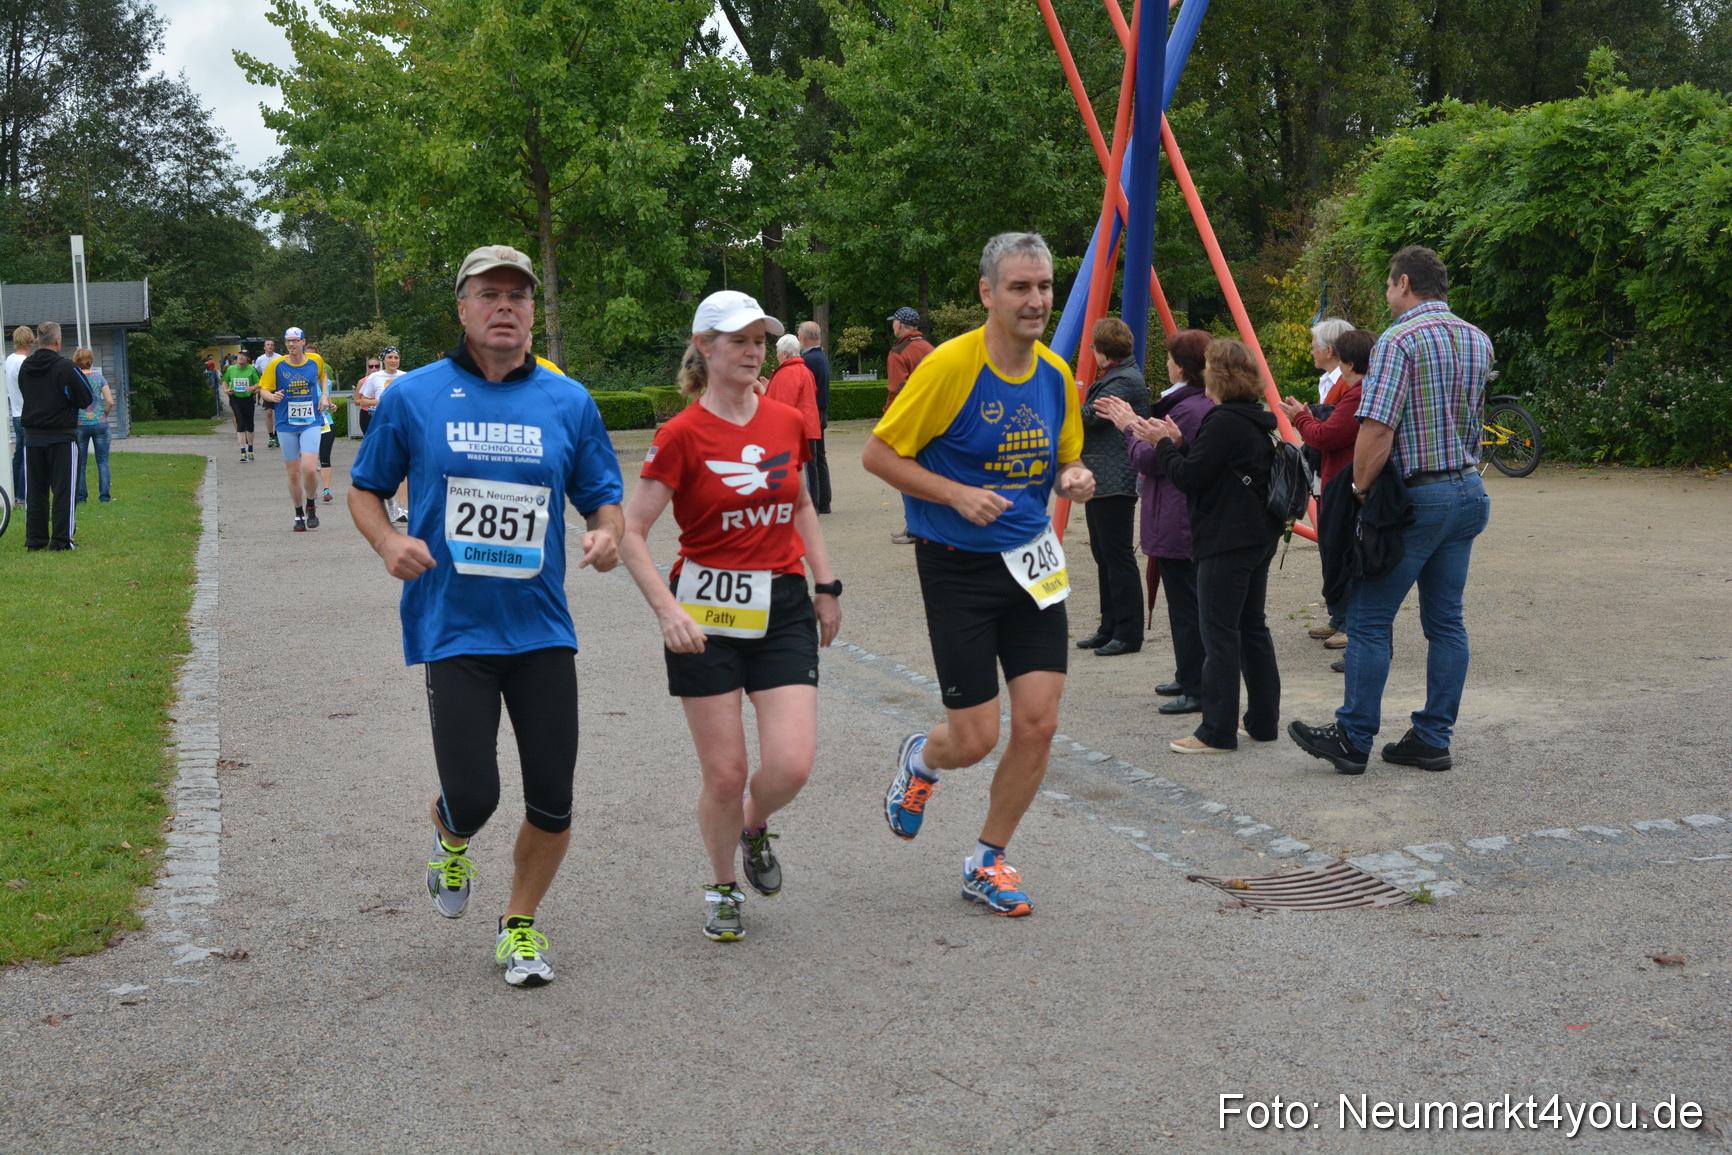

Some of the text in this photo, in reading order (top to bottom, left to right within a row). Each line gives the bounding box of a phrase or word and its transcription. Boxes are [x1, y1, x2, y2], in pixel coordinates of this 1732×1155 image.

[291, 407, 312, 417] 2174
[446, 421, 542, 446] HUBER
[468, 443, 539, 454] TECHNOLOGY
[467, 453, 489, 461] WASTE
[515, 456, 541, 464] Solutions
[450, 486, 533, 504] PARTL Neumarkt
[455, 502, 535, 542] 2851
[721, 503, 793, 531] RWB
[464, 546, 523, 565] Christian
[1022, 540, 1060, 581] 248
[696, 569, 752, 605] 205
[1042, 577, 1063, 594] Mark
[705, 610, 736, 627] Patty
